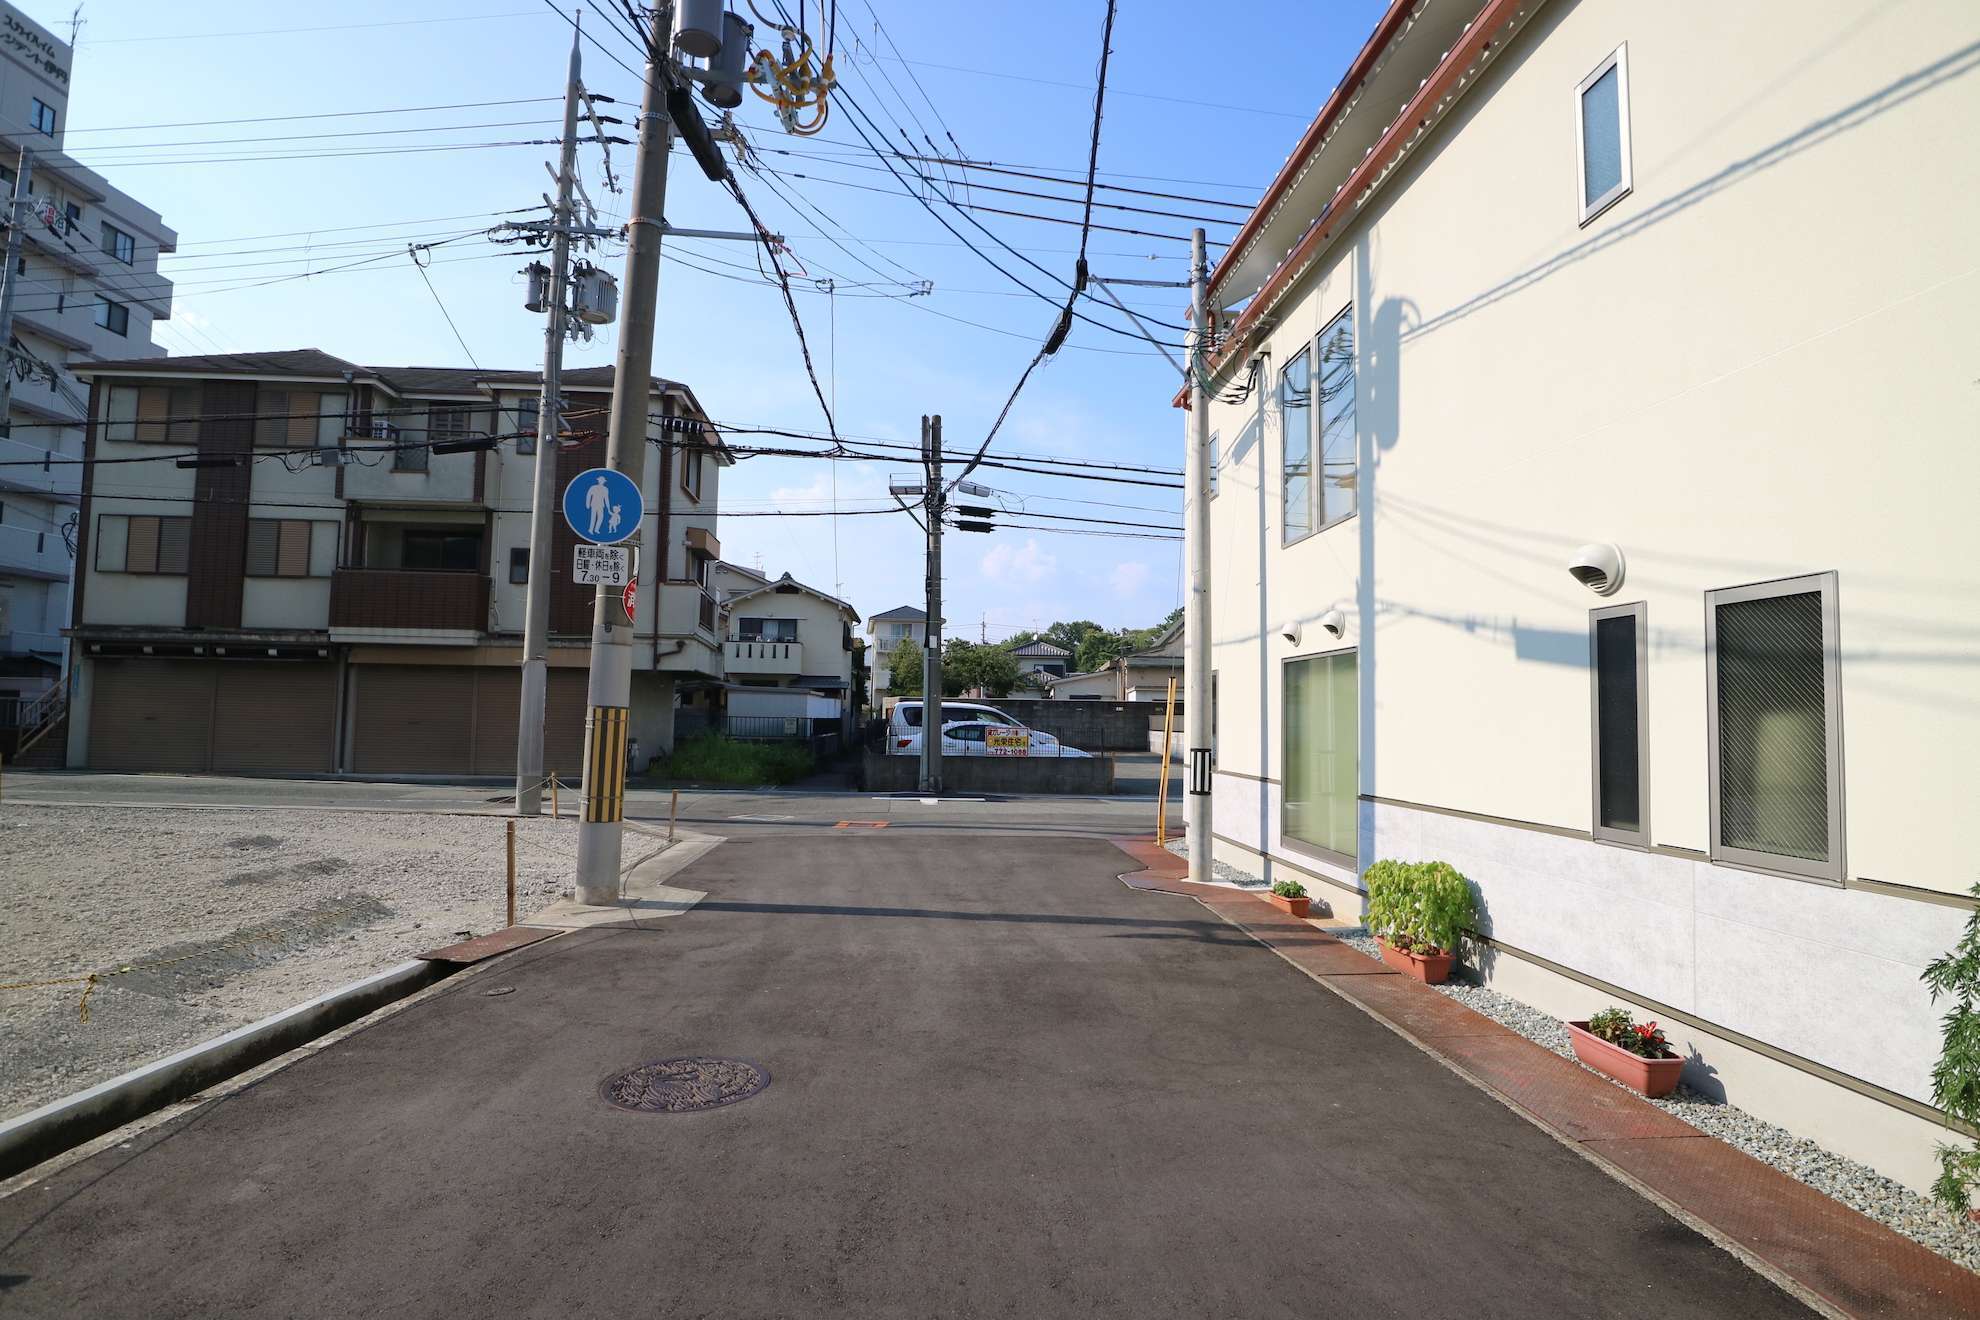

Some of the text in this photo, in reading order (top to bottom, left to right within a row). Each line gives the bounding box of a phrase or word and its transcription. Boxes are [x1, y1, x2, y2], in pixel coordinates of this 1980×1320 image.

[578, 547, 625, 561] 軽車両を除く
